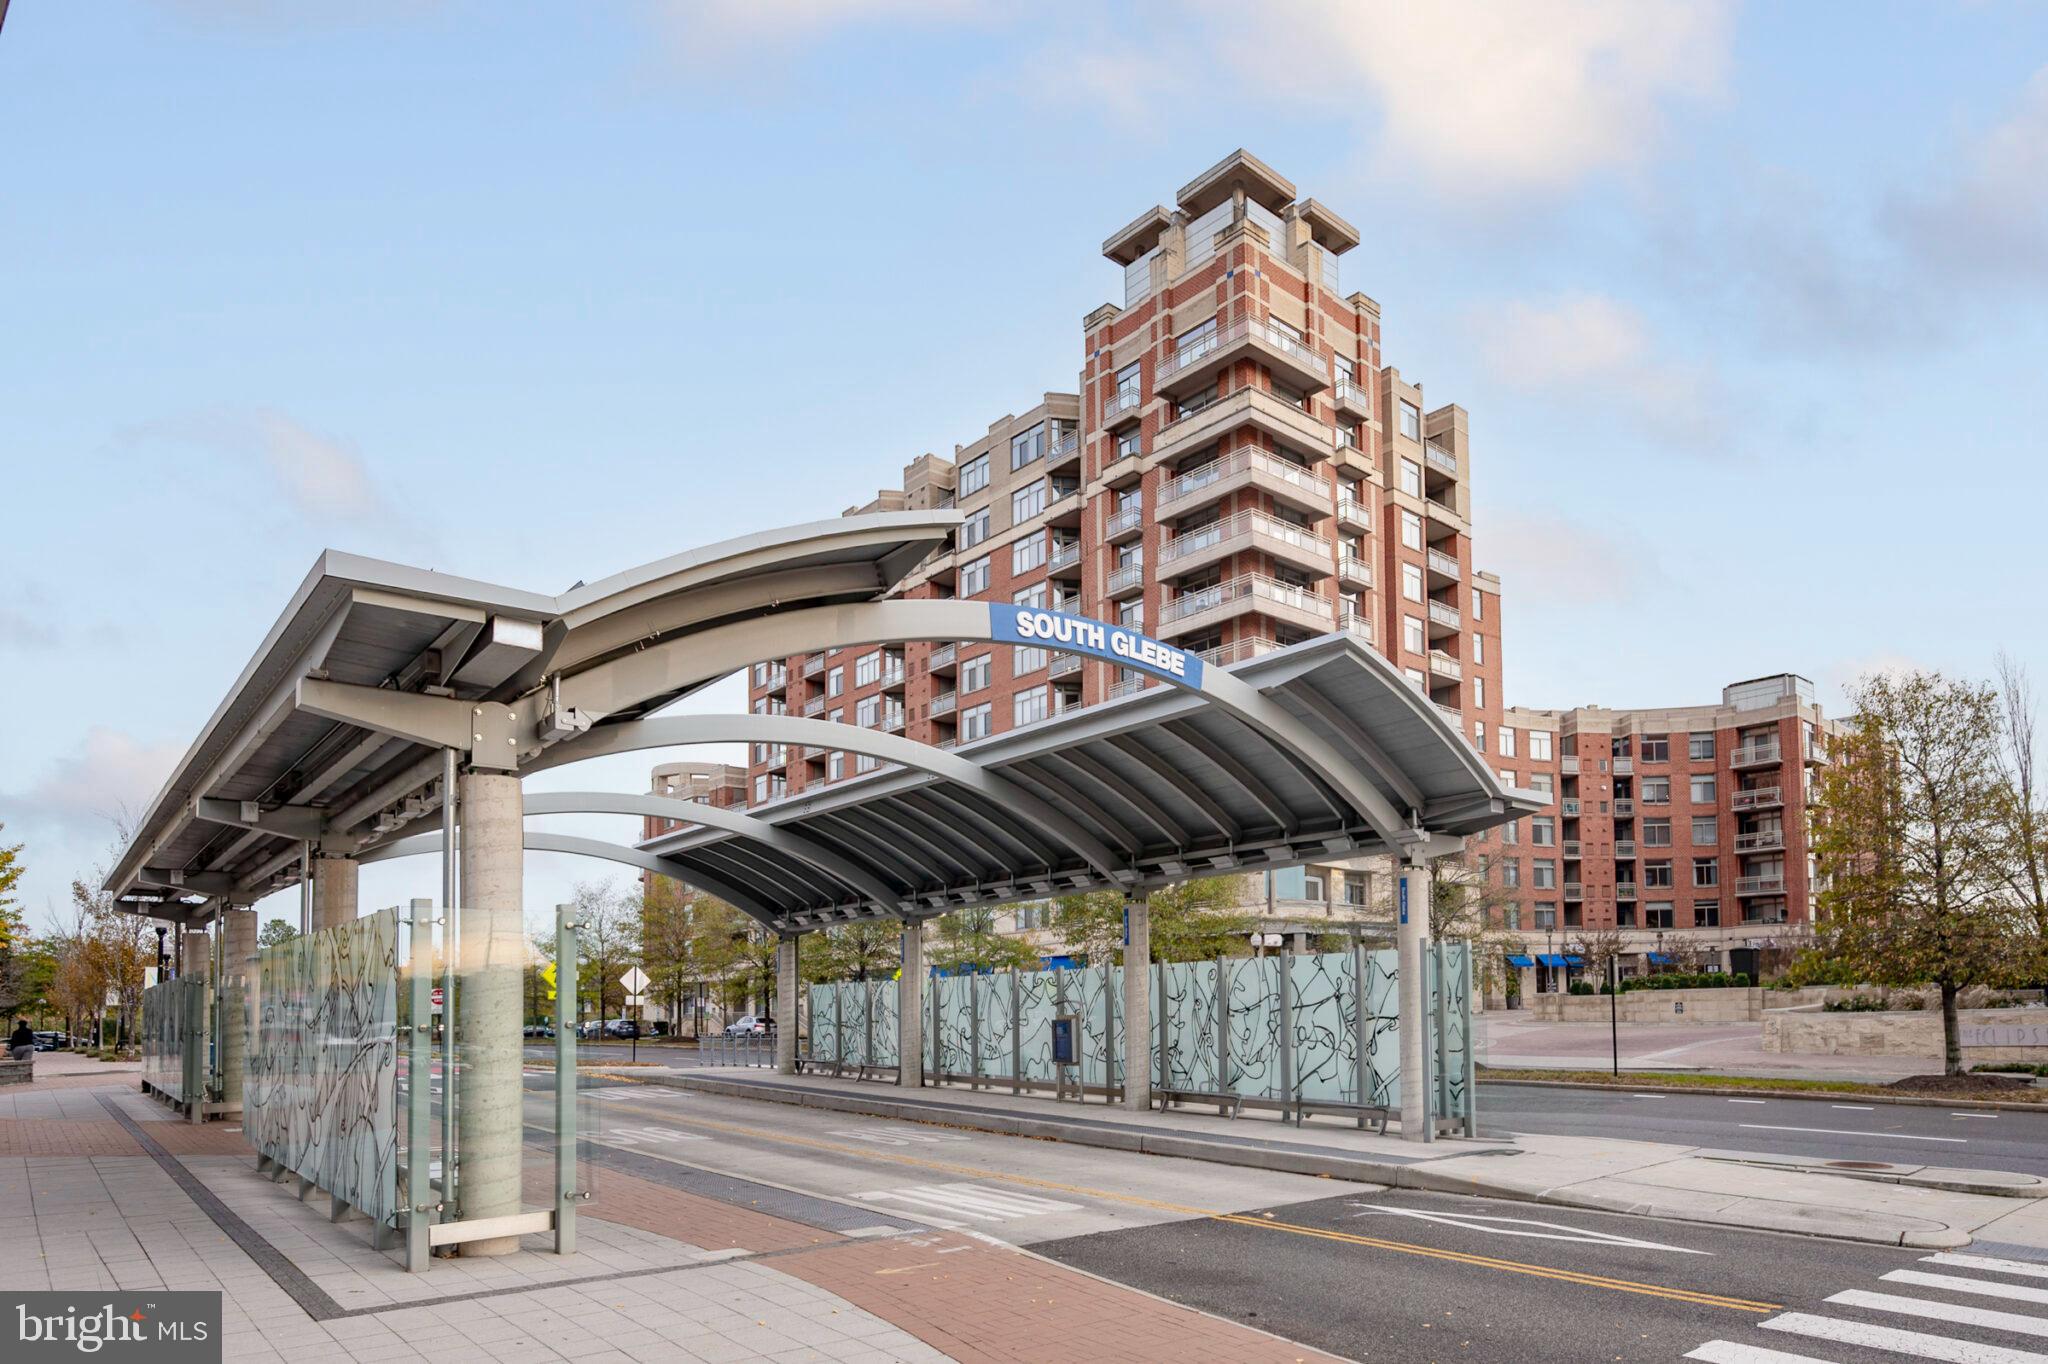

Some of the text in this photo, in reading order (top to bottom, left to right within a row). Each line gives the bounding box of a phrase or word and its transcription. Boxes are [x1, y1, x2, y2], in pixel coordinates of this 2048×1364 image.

[1016, 610, 1185, 677] SOUTH GLEBE
[1976, 1026, 2048, 1046] ECLIPS
